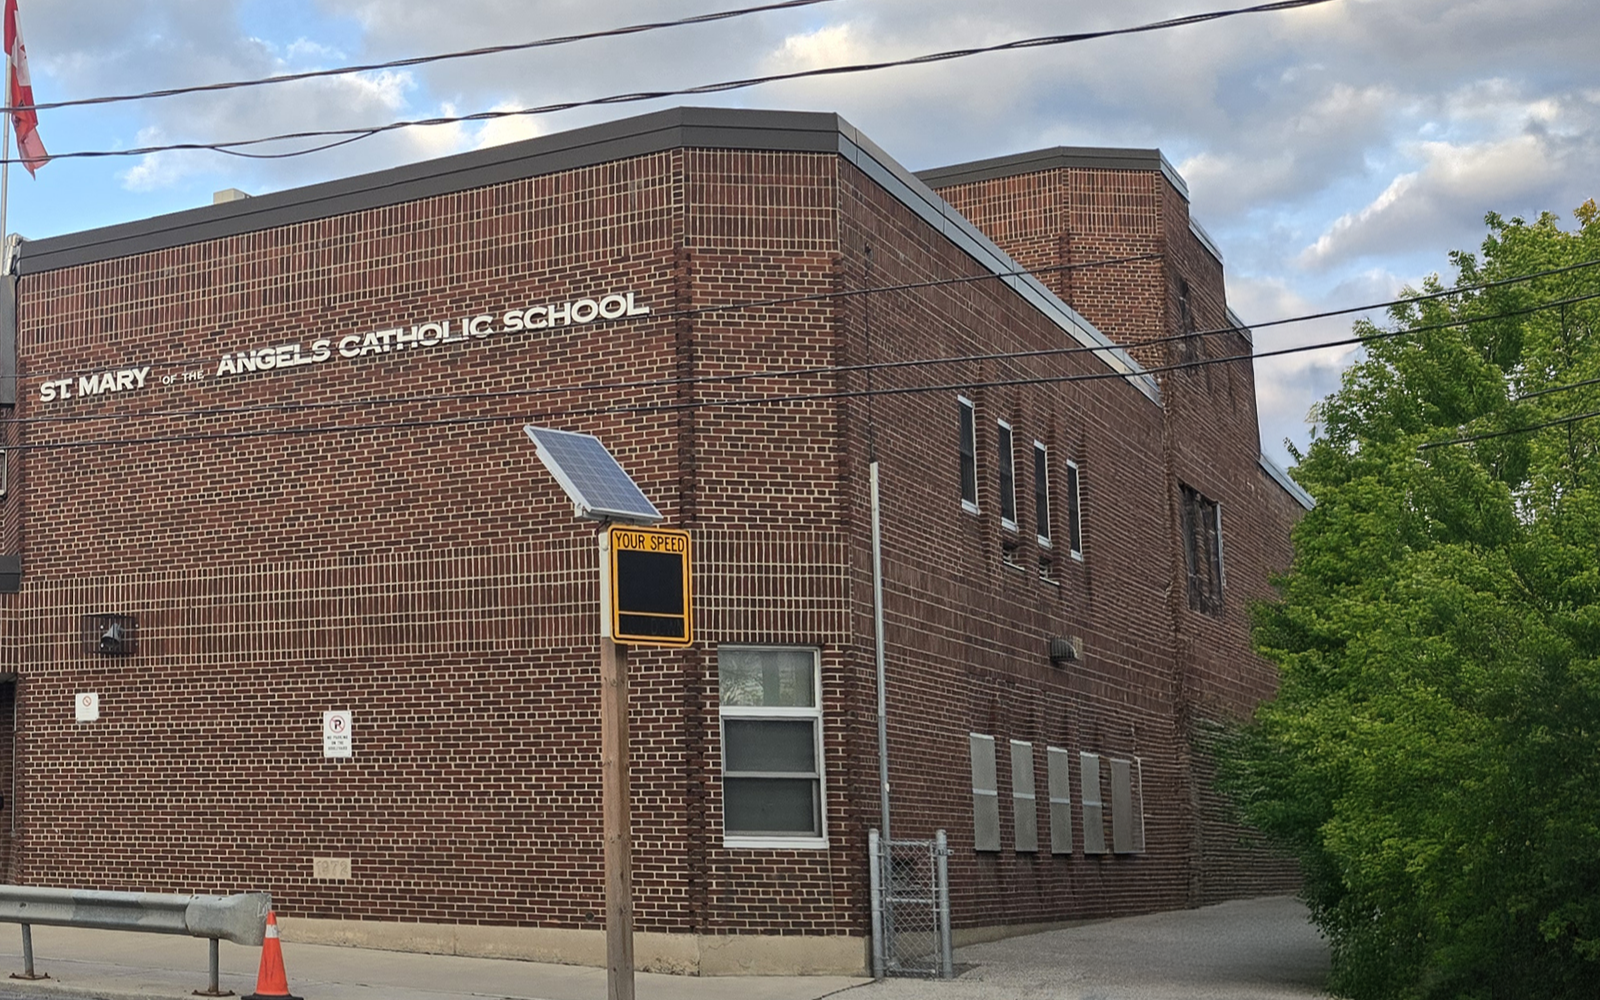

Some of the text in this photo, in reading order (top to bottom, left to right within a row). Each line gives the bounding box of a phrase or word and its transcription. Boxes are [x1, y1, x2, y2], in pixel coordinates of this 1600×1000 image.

[40, 292, 650, 402] ST. MARY OF THE ANGELS CATHOLIC SCHOOL
[615, 532, 685, 553] YOUR SPEED
